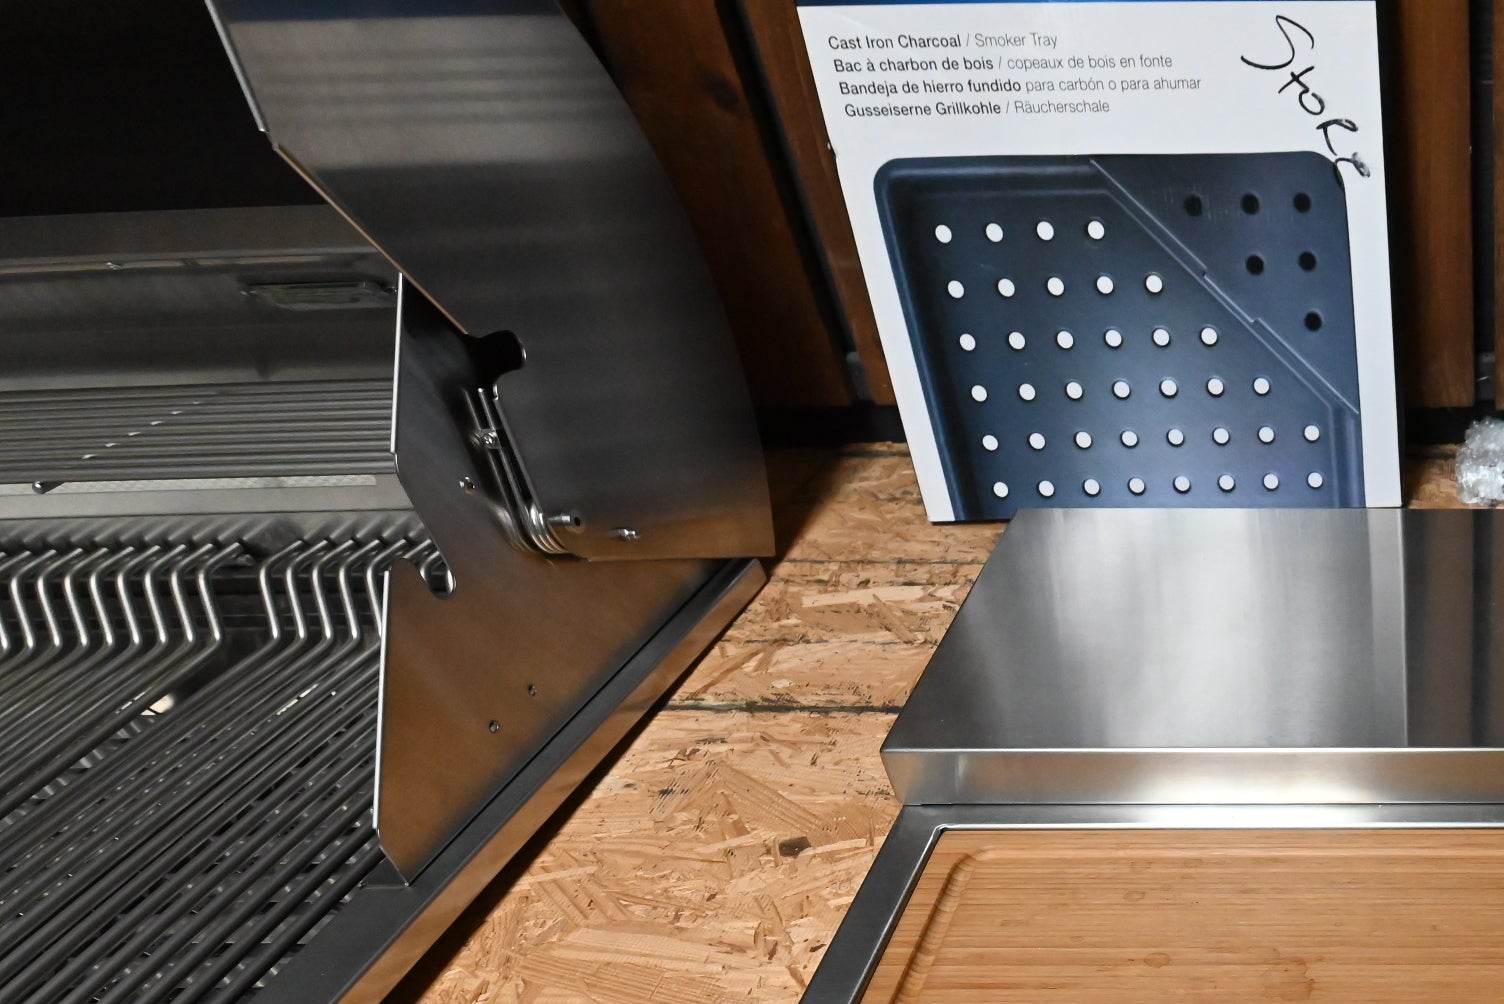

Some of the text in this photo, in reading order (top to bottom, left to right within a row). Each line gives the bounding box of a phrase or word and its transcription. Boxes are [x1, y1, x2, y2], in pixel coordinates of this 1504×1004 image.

[828, 35, 862, 50] Cast
[865, 35, 894, 49] Iron
[897, 33, 962, 49] Charcoal
[974, 32, 1026, 48] Smoker
[1029, 32, 1058, 49] Tray
[833, 58, 862, 73] Bac
[866, 57, 876, 72] à
[879, 57, 938, 72] charbon
[941, 56, 960, 71] de
[963, 56, 994, 70] bois
[1007, 56, 1064, 73] copeaux
[1067, 55, 1085, 69] de
[1088, 54, 1116, 69] bois
[1119, 56, 1136, 68] en
[1140, 53, 1173, 68] fonte
[838, 76, 1202, 98] Bandeja de hierro fundido para carbón o para ahumar
[844, 102, 932, 118] Gusseiserne
[935, 101, 1001, 116] Grillkohle
[1013, 99, 1110, 114] Räucherschale
